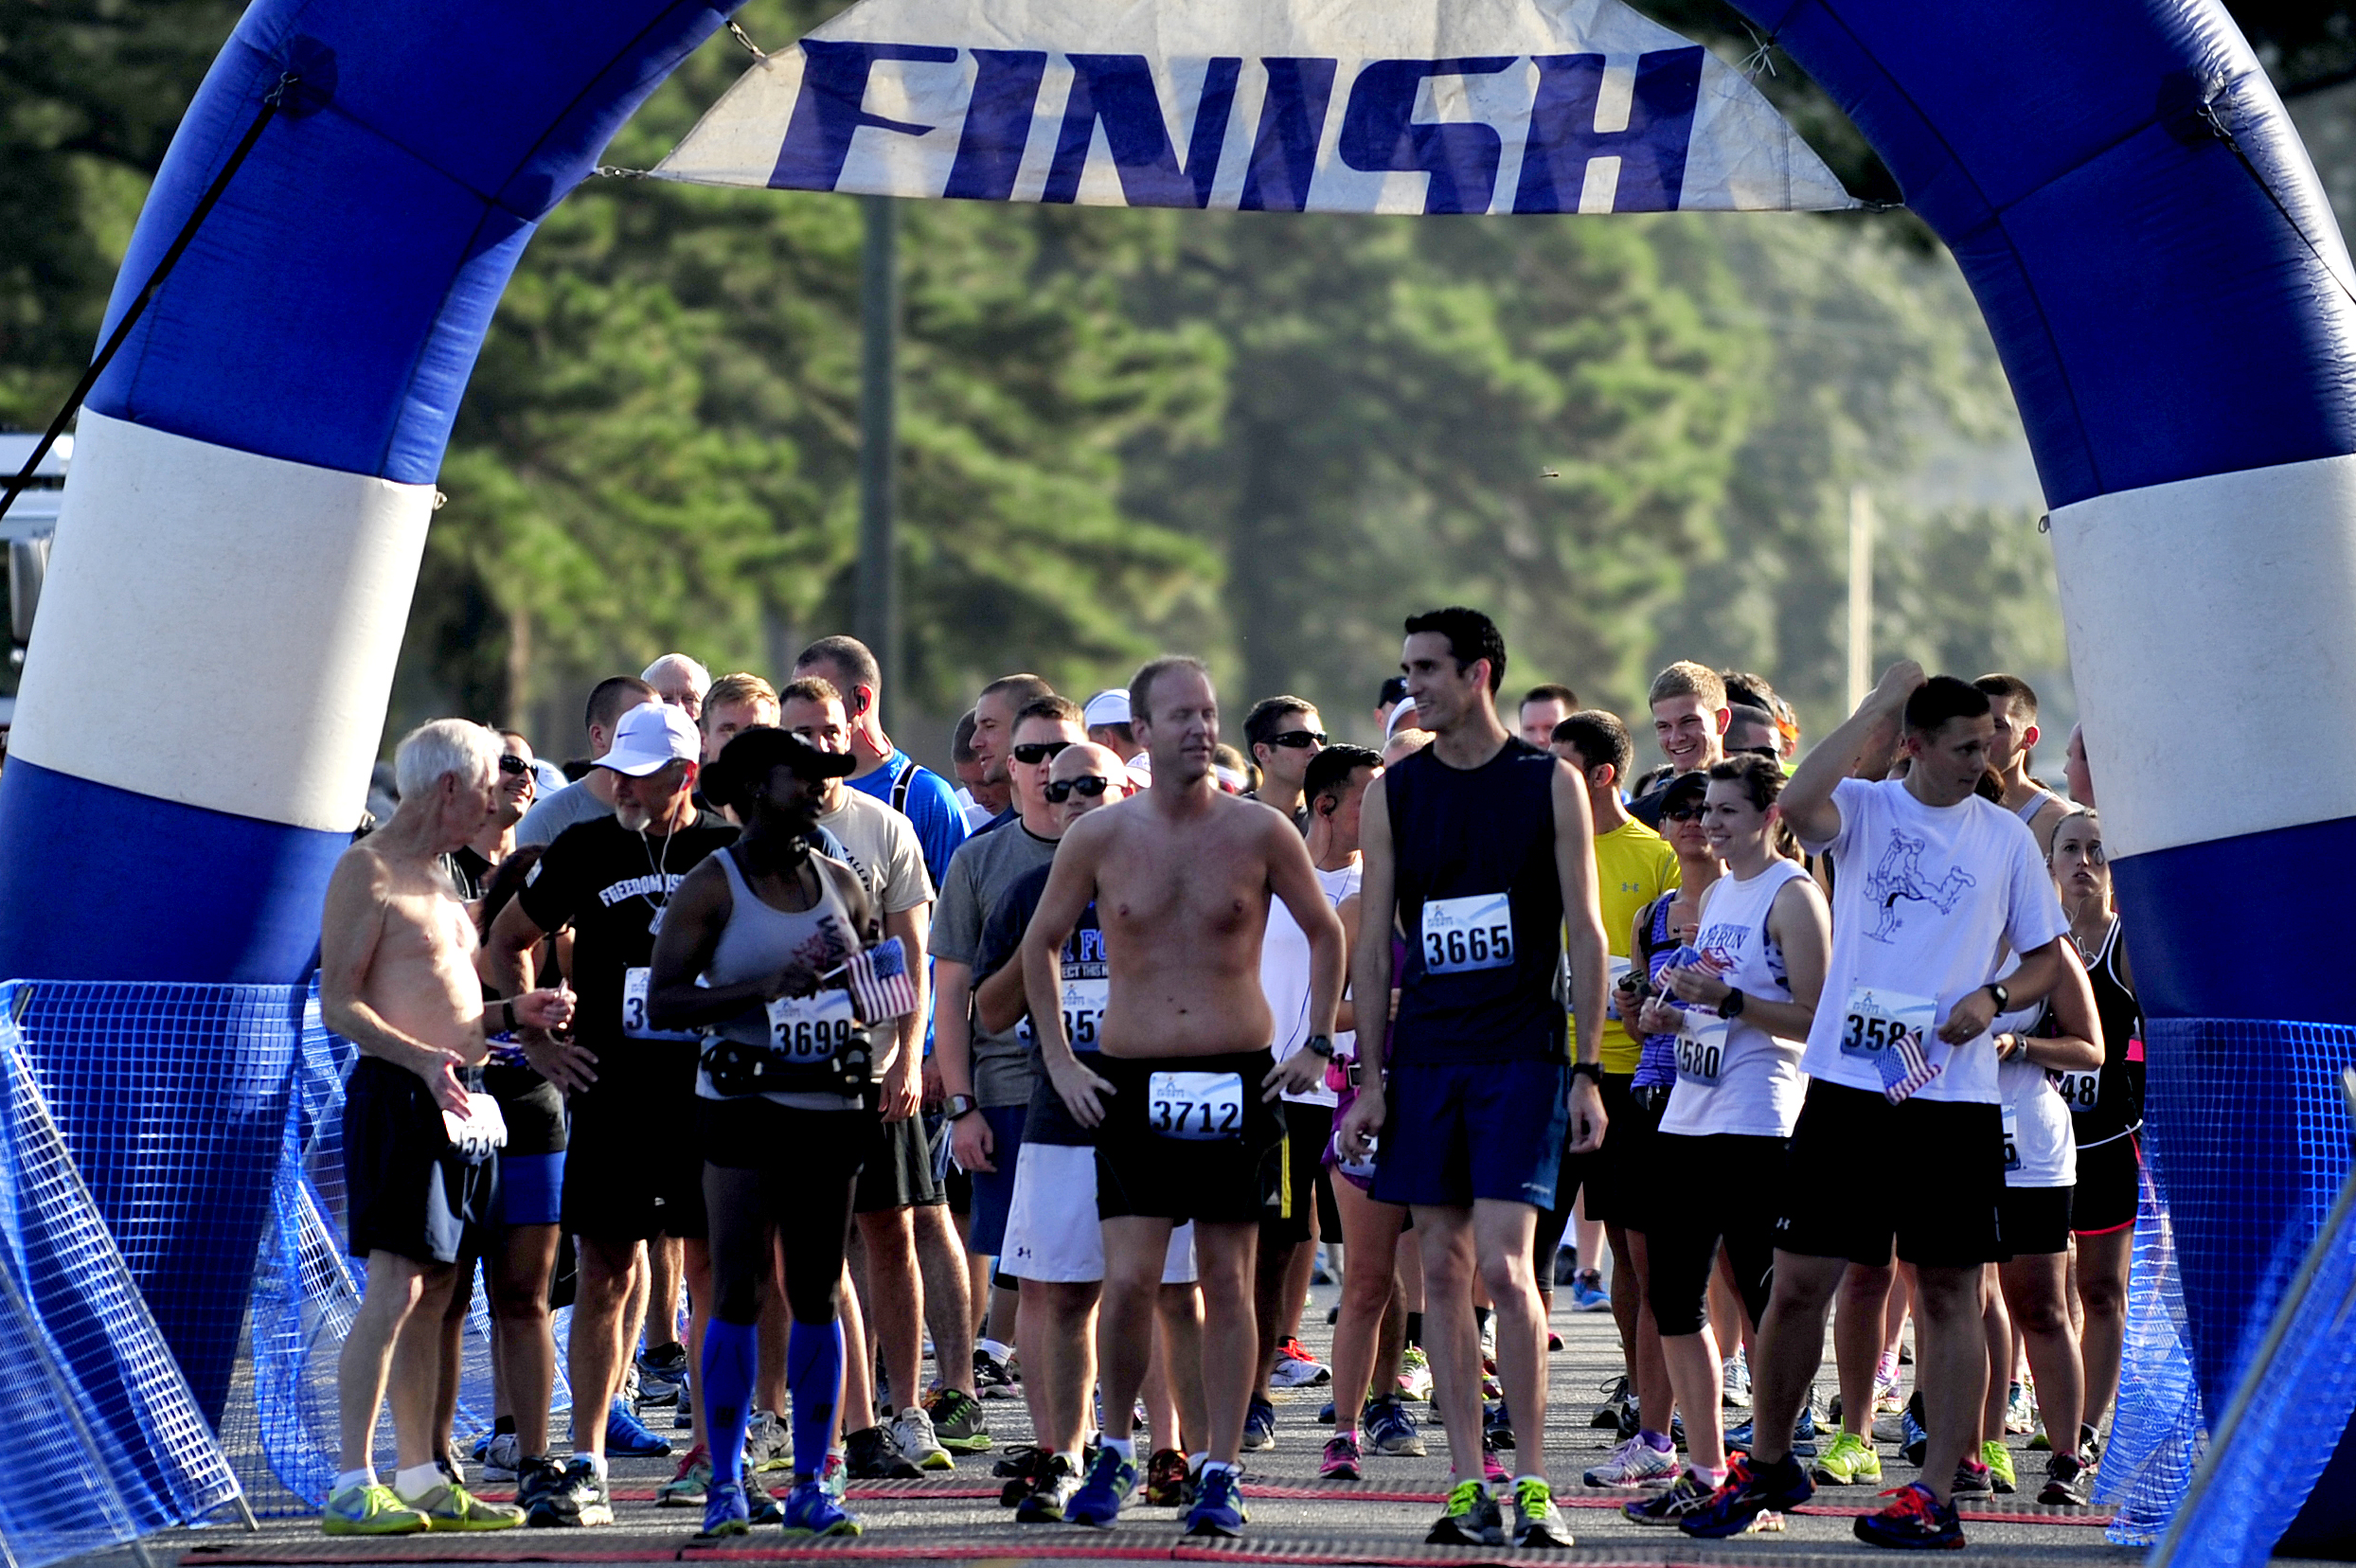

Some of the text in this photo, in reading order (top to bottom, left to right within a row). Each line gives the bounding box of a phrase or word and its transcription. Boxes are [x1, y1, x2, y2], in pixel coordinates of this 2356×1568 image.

[768, 40, 1705, 216] FINISH
[1426, 924, 1510, 967] 3665
[774, 1019, 850, 1057] 3699
[2059, 1074, 2097, 1106] 48
[1153, 1100, 1239, 1132] 3712
